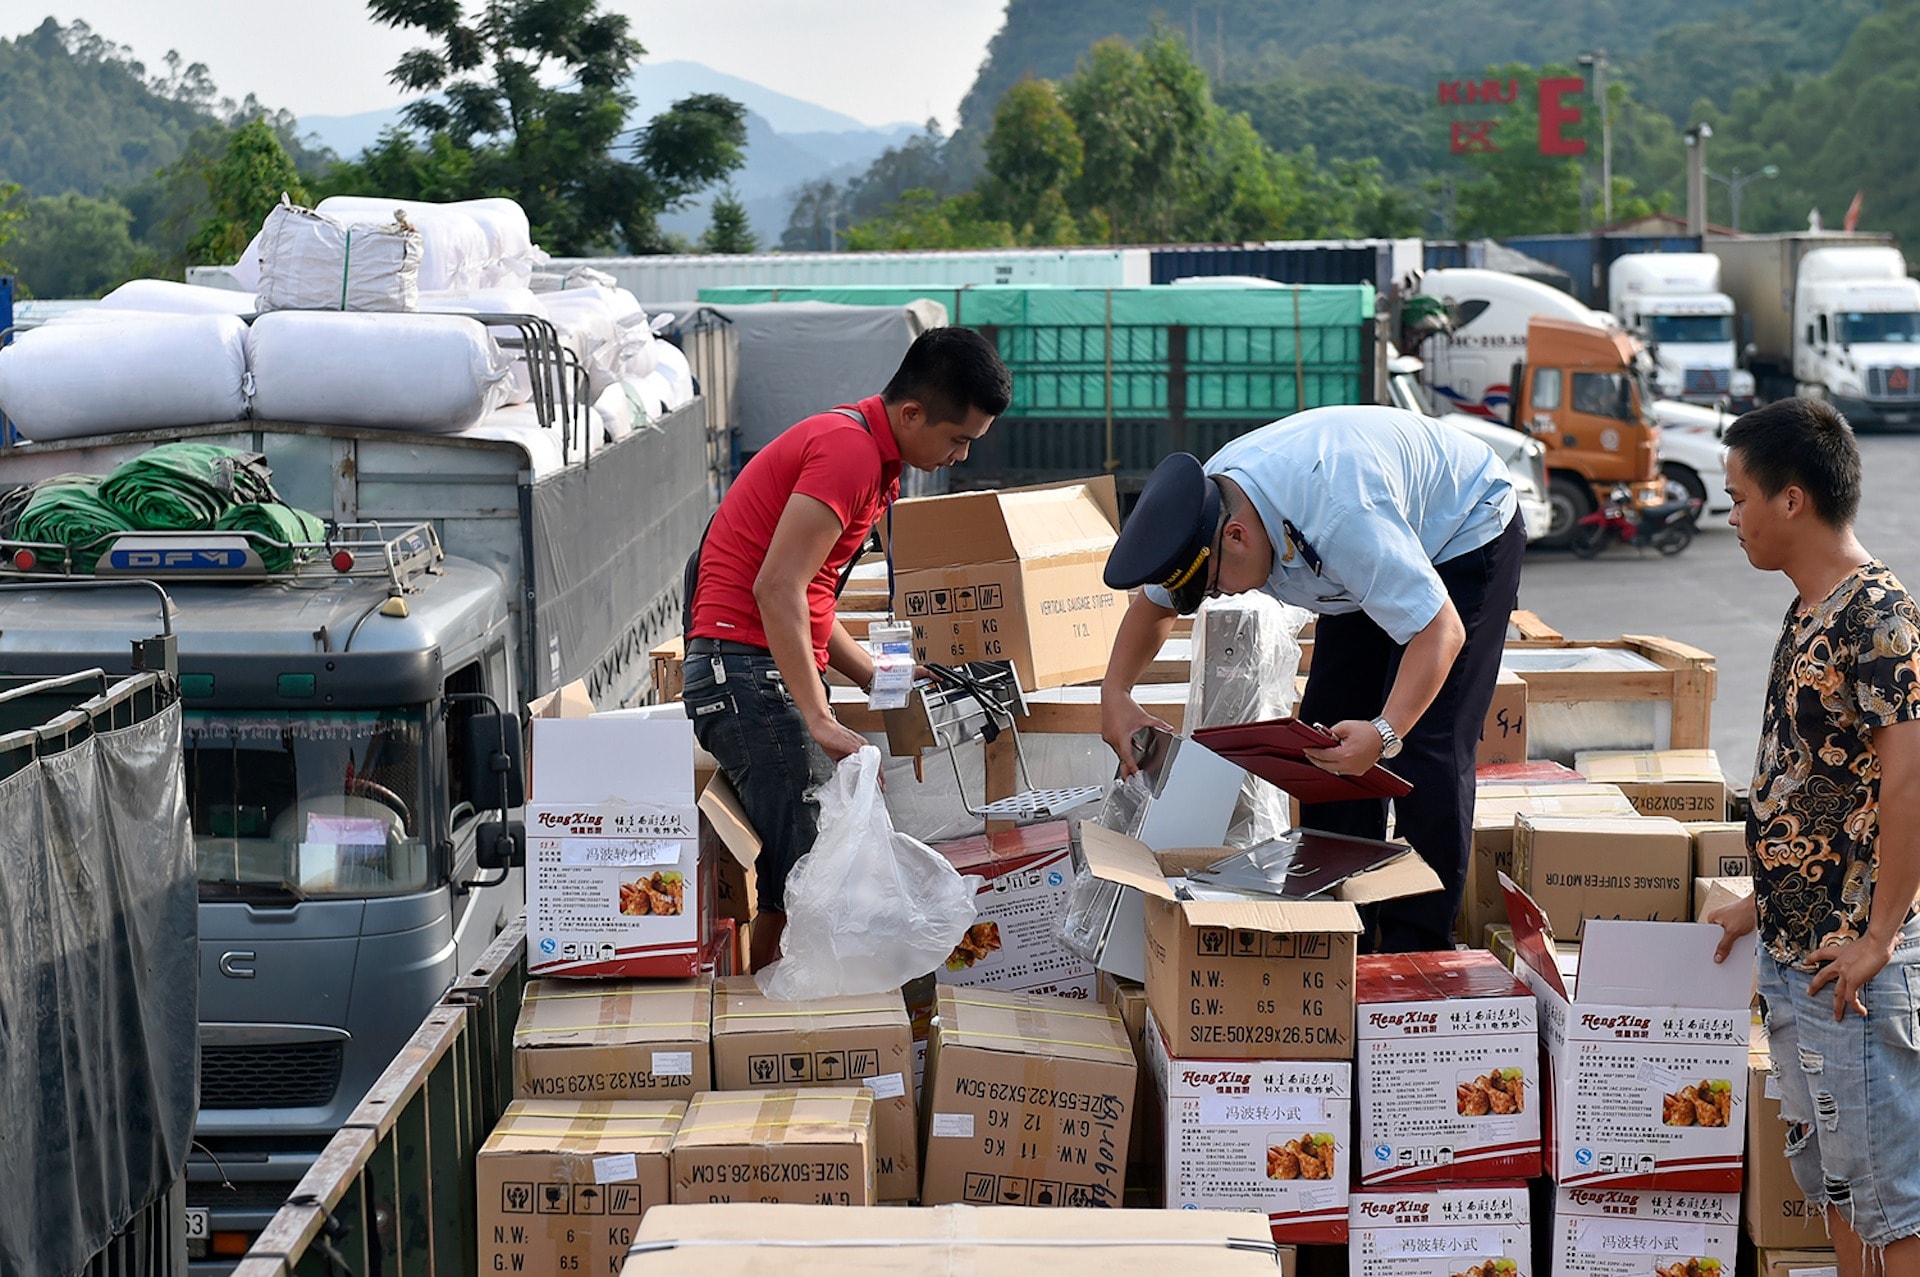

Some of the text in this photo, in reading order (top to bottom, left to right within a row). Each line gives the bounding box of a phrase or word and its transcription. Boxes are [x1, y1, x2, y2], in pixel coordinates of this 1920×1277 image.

[1438, 79, 1518, 105] KHU
[1538, 78, 1587, 156] E
[129, 551, 229, 567] DFM
[1040, 593, 1114, 616] VERTICAL SAUSAGE STUFFER
[954, 624, 960, 635] 6
[982, 618, 998, 634] KG
[916, 640, 1001, 661] W 6.5 KG
[538, 813, 603, 828] HengXing
[1546, 873, 1680, 890] SAUSAGE STUFFER MOTOR
[1262, 973, 1270, 986] 6
[1303, 972, 1324, 988] KG
[1257, 1000, 1274, 1014] 6.5
[1303, 1000, 1323, 1016] KG
[1369, 1011, 1438, 1028] HengXing
[1581, 1014, 1652, 1031] HengXing
[1664, 1031, 1700, 1039] HX-81
[1182, 1071, 1252, 1087] HengXing
[988, 1109, 1009, 1128] KG
[1225, 1106, 1302, 1121] 冯波转小武
[1024, 1113, 1041, 1132] 12
[984, 1138, 1005, 1156] KG
[1021, 1142, 1038, 1160] 11
[1568, 1188, 1640, 1206] HengXing
[1360, 1200, 1430, 1217] HengXing
[1444, 1213, 1480, 1221] HX-81
[1653, 1208, 1688, 1217] HX-81
[566, 1230, 575, 1242] 6
[608, 1228, 630, 1246] KG
[1402, 1238, 1478, 1252] 冯波转小武
[1602, 1235, 1679, 1251] 冯波转小武
[560, 1256, 579, 1270] 6.5
